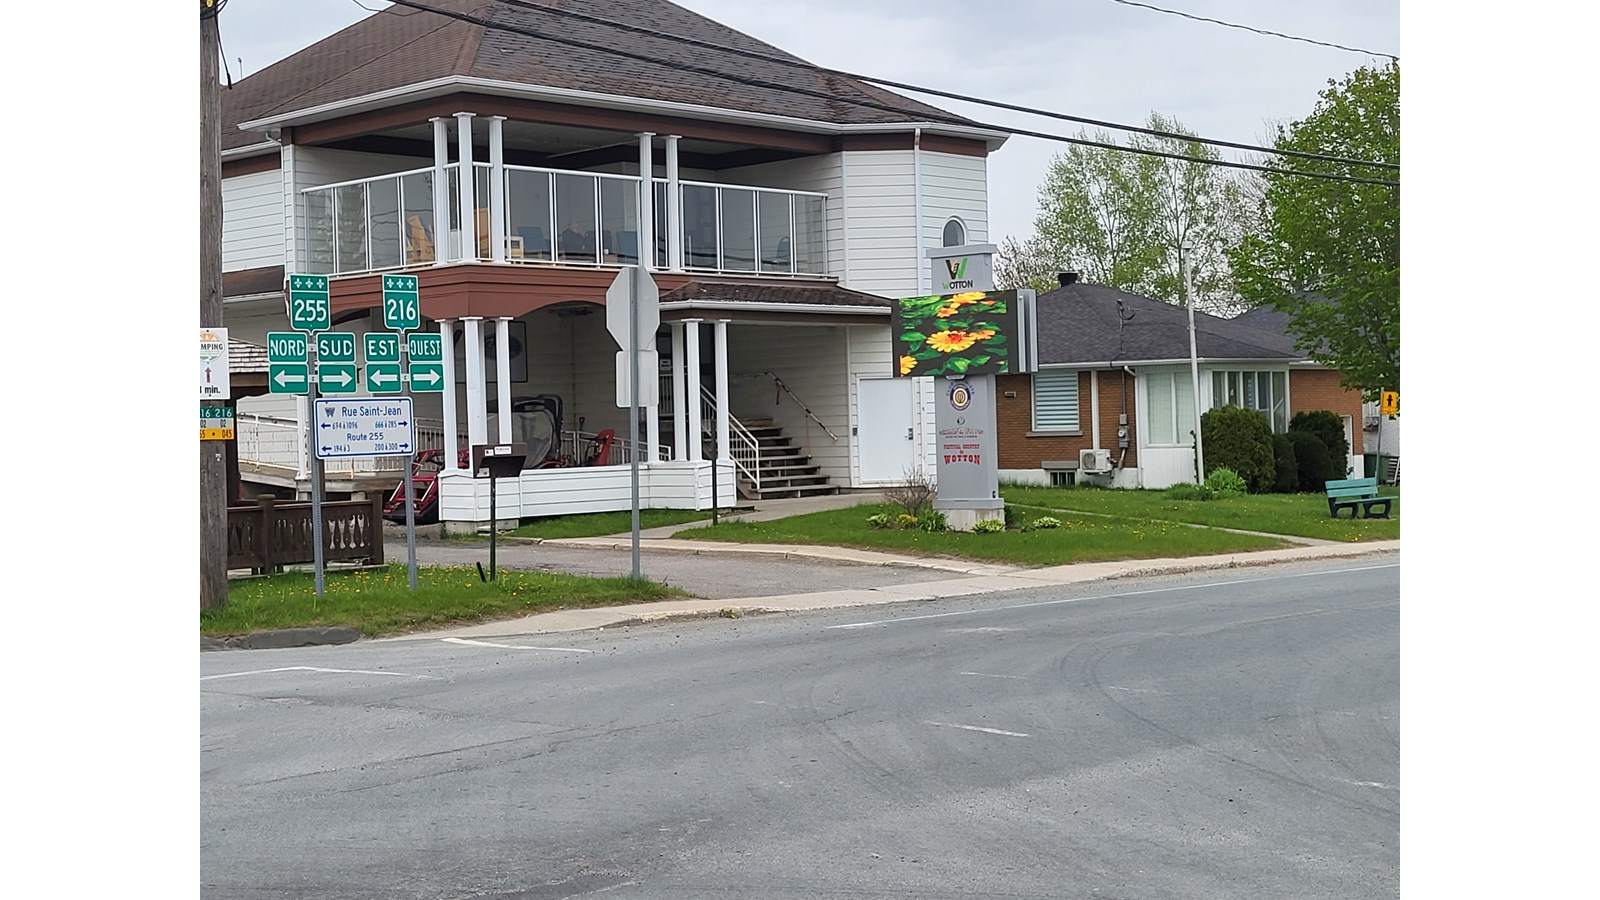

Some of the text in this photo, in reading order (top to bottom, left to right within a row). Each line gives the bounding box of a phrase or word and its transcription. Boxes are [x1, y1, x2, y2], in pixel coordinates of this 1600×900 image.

[942, 280, 974, 290] WOTTON
[294, 299, 327, 321] 255
[387, 298, 416, 321] 216
[200, 343, 223, 351] MPING
[270, 339, 305, 356] NORD
[320, 339, 353, 356] SUD
[368, 339, 396, 356] EST
[410, 339, 440, 356] OUEST
[204, 385, 221, 394] min.
[215, 408, 232, 418] 216
[341, 405, 402, 417] Rue Saint-Jean
[388, 420, 397, 428] 285
[346, 432, 384, 441] Route 255
[943, 454, 980, 465] WOTTON
